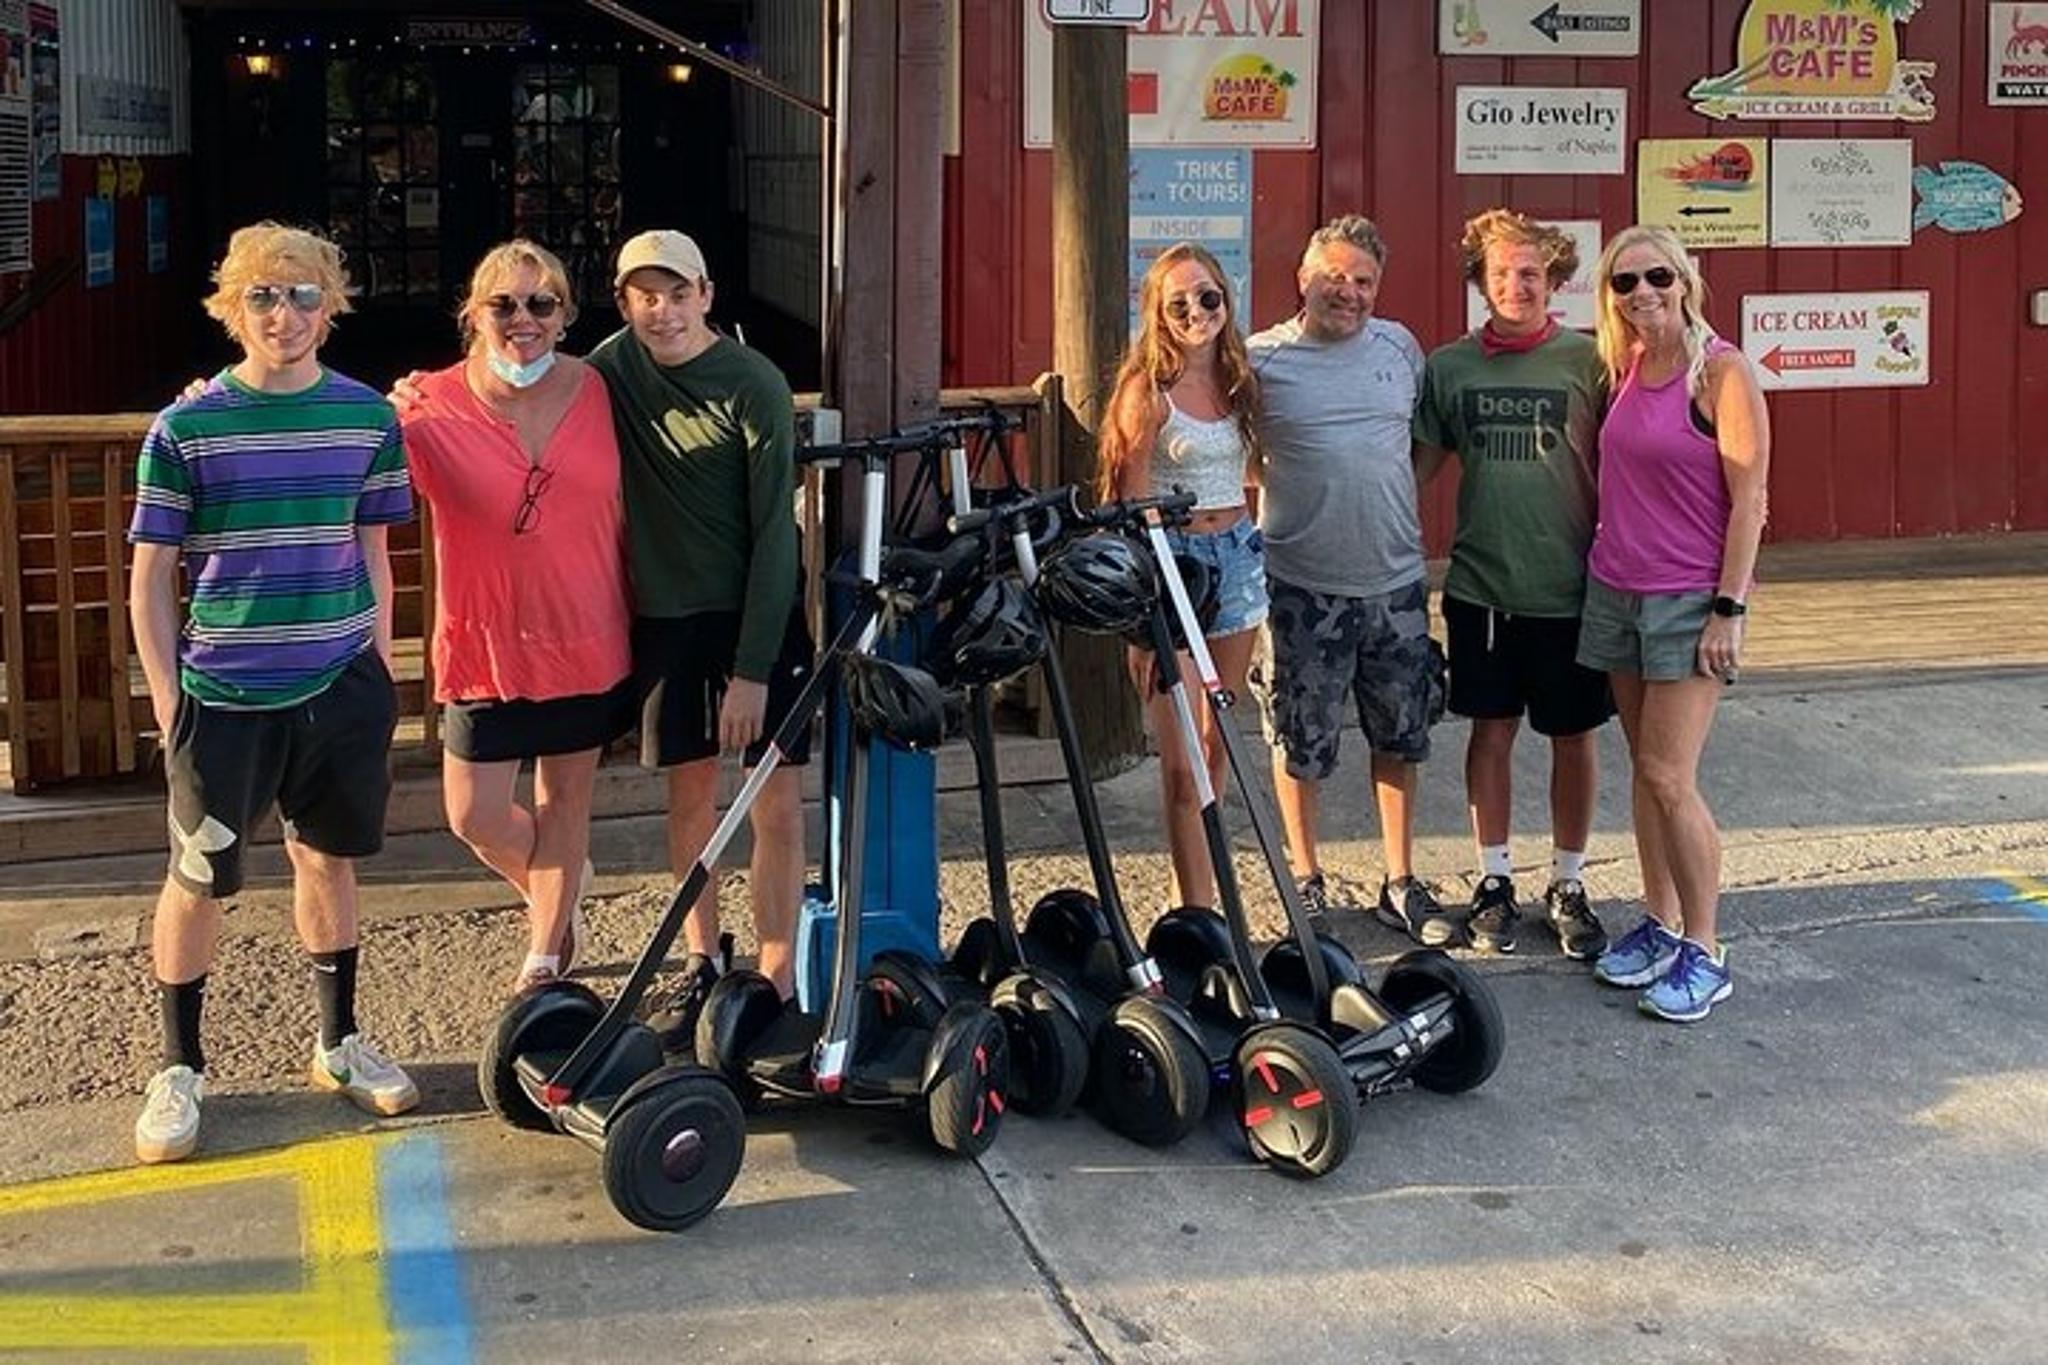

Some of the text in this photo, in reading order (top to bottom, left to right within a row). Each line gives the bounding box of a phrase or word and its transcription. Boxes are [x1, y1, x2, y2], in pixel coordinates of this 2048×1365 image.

[1766, 14, 1878, 45] M&M's
[1770, 50, 1873, 78] CAFE
[1216, 96, 1276, 113] CAFE
[1745, 101, 1767, 115] ICE
[1774, 101, 1830, 115] CREAM
[1832, 101, 1843, 114] &
[1848, 101, 1893, 115] GRILL
[1466, 99, 1619, 132] Gio Jewelry
[1575, 138, 1618, 156] Naples
[1175, 160, 1240, 181] TRIKE
[1167, 181, 1249, 203] TOURS!
[1152, 219, 1210, 237] INSIDE
[1752, 310, 1868, 333] ICE CREAM
[1779, 352, 1853, 367] FREE SAMPLE
[1477, 394, 1551, 418] beer
